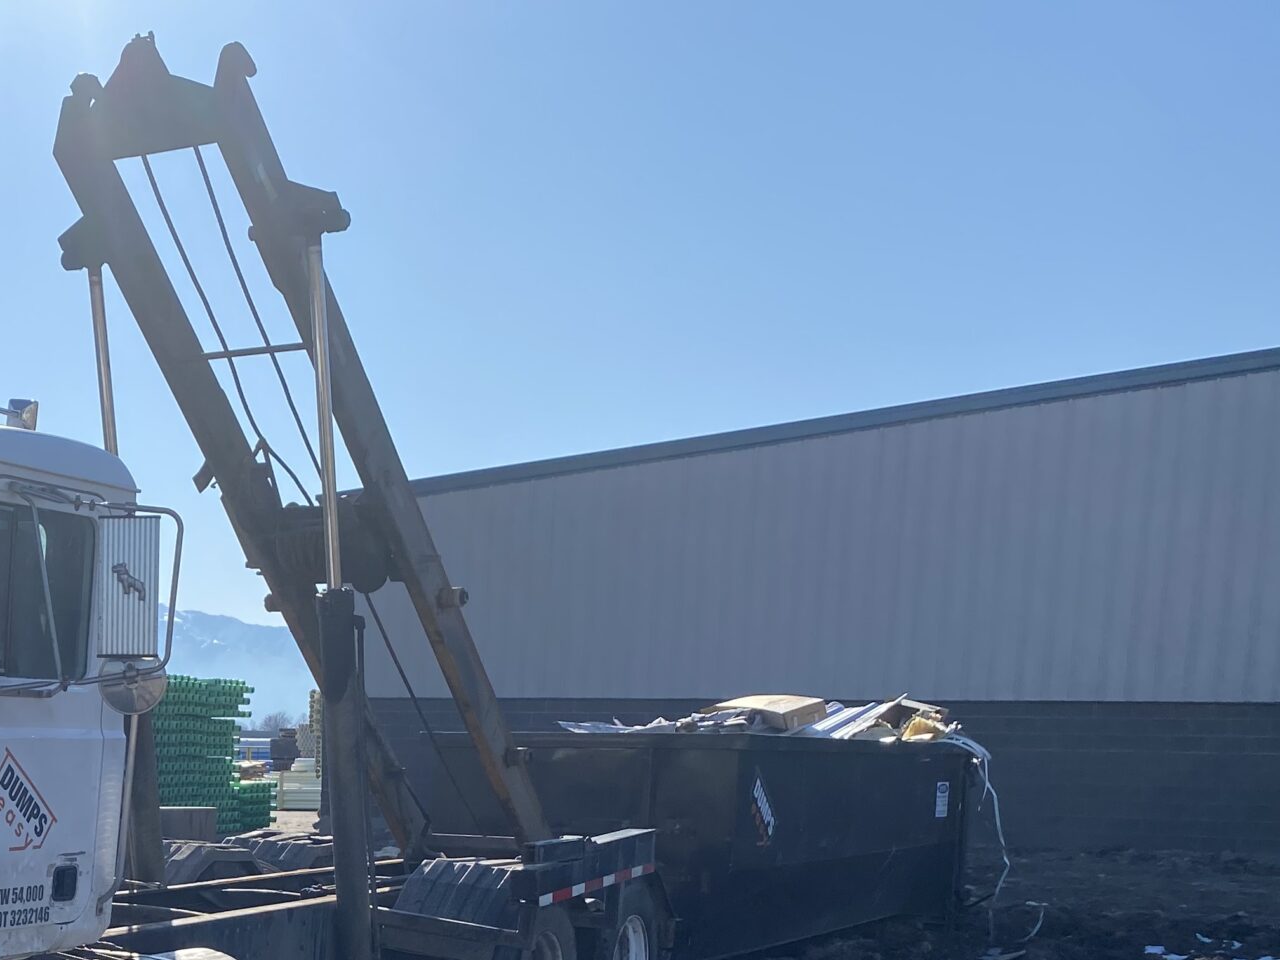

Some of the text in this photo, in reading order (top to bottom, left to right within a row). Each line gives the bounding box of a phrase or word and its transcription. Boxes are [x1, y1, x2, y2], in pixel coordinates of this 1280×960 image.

[0, 764, 48, 837] DUMPS
[753, 777, 775, 836] DUMPS
[11, 885, 44, 905] 54,000
[10, 907, 50, 926] 3232146
